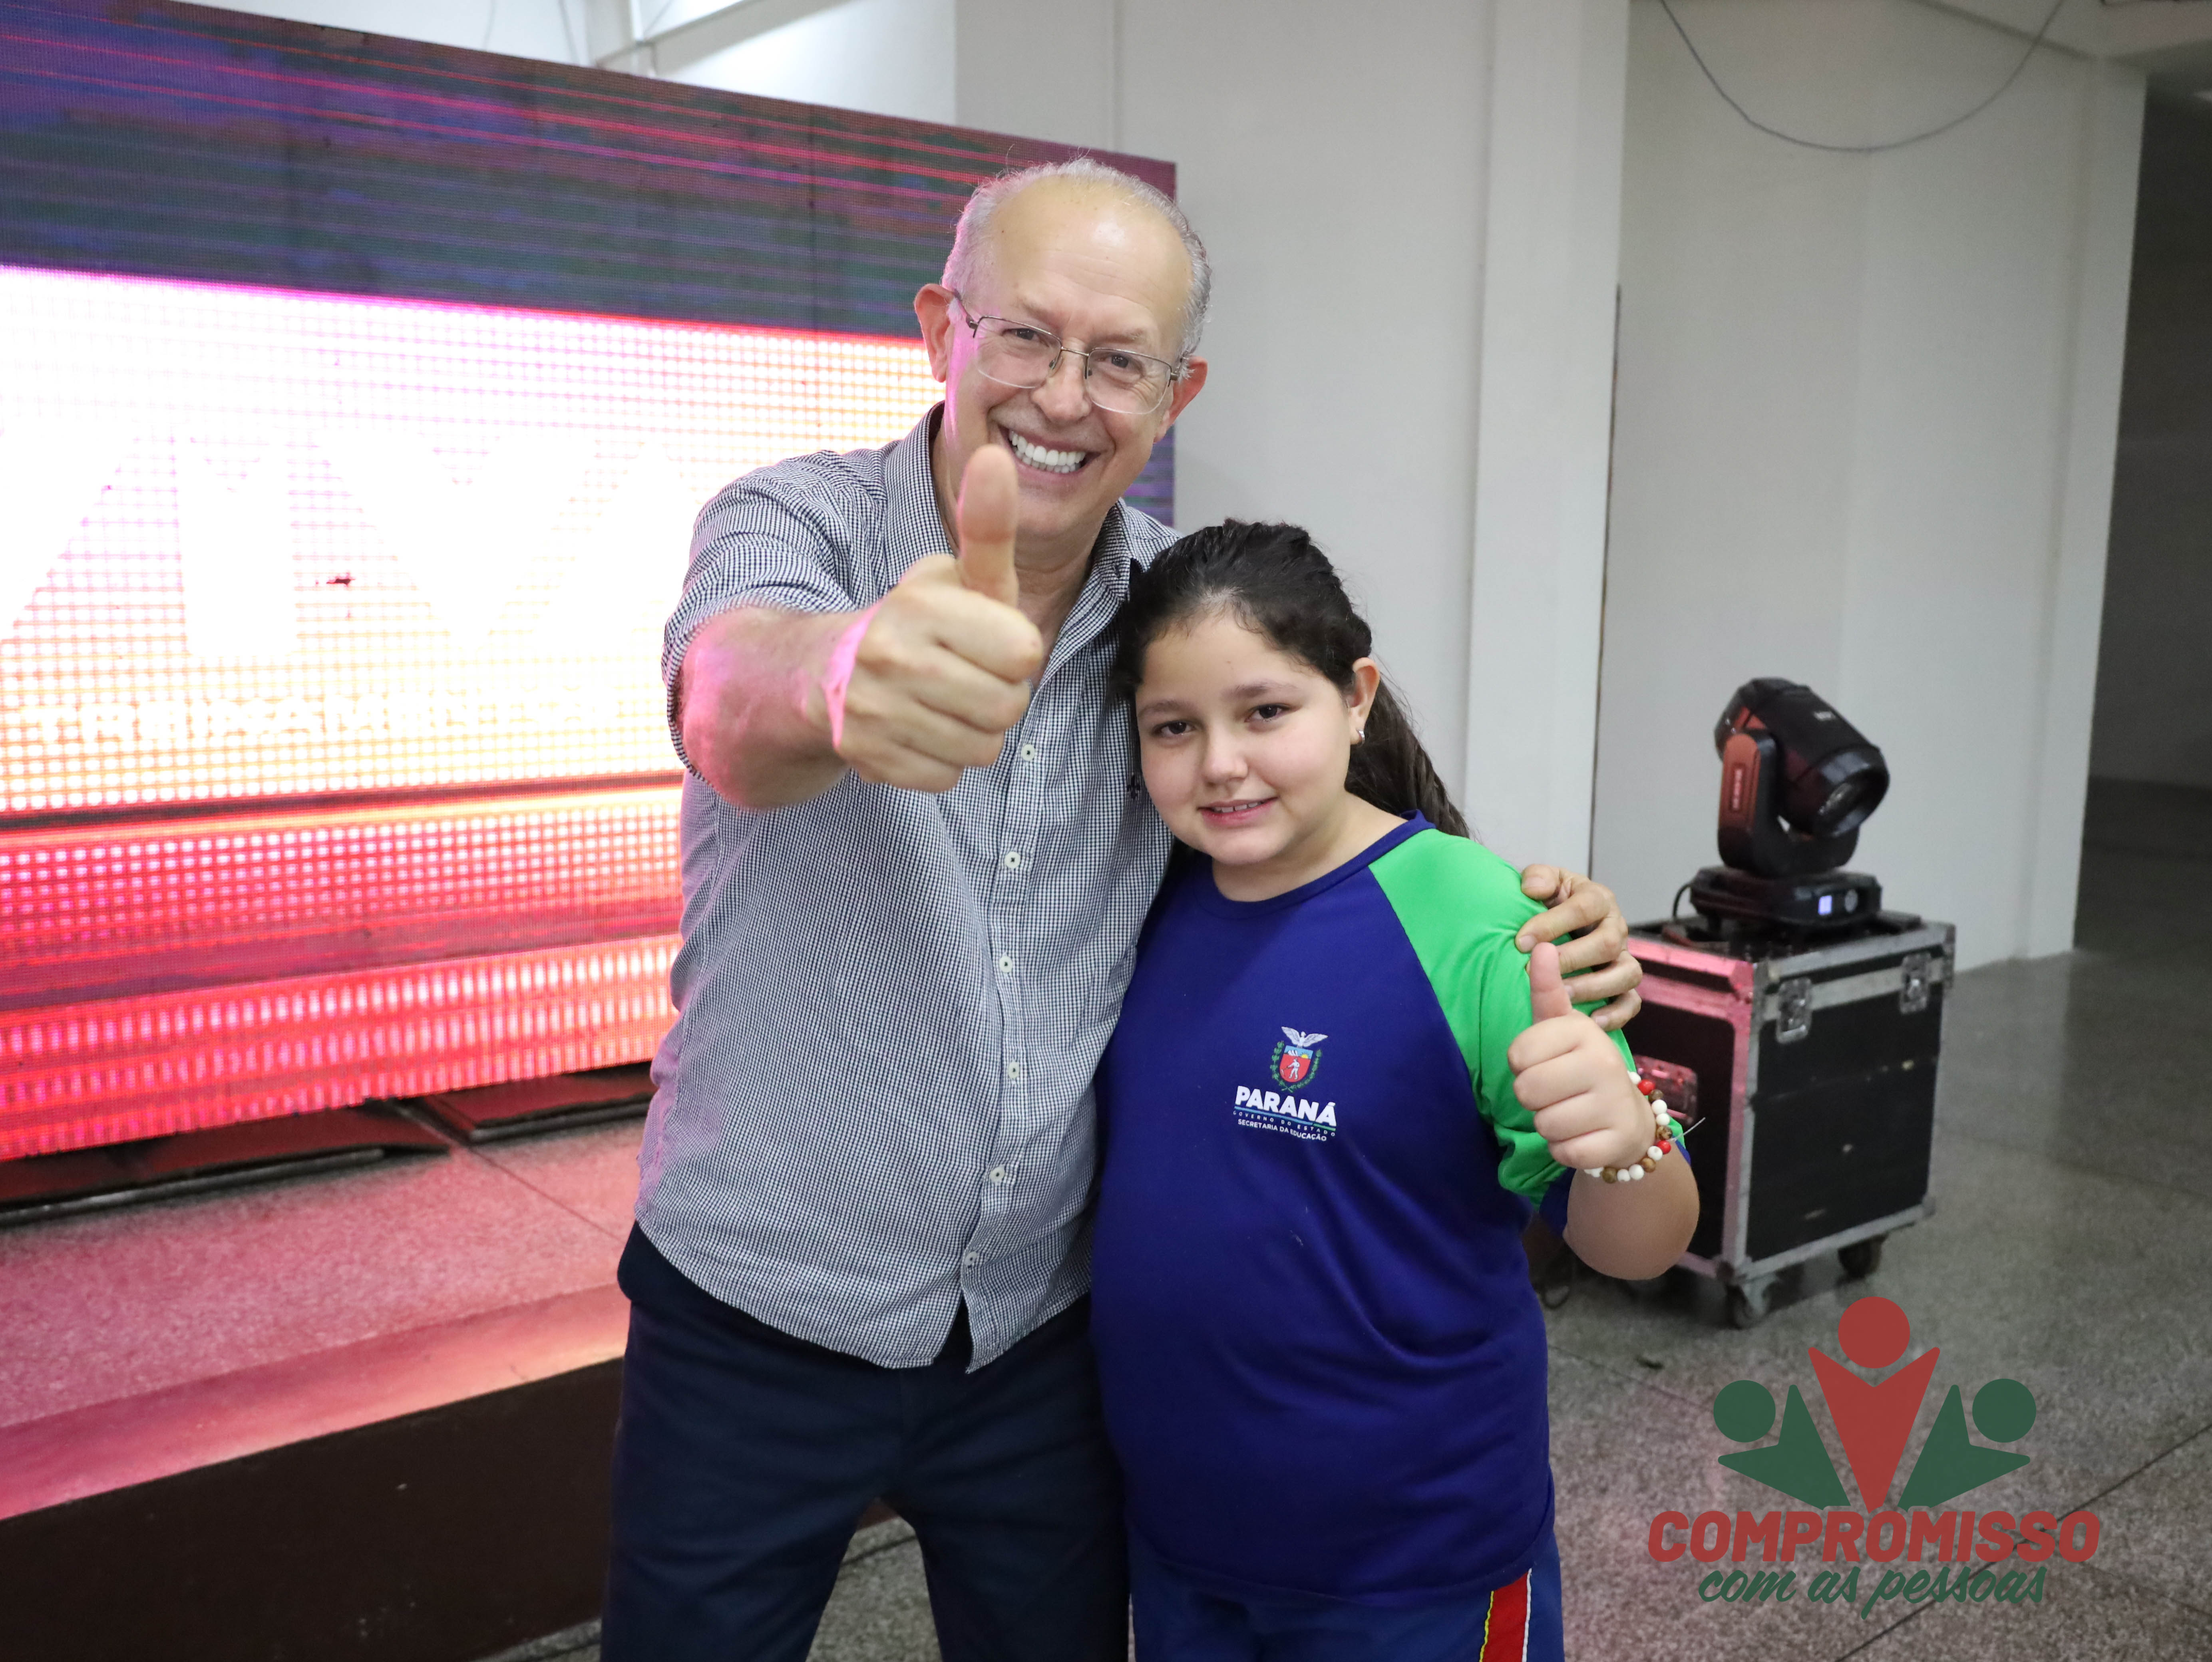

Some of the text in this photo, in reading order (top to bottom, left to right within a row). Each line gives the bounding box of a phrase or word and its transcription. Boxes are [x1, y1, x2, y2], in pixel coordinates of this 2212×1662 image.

[1235, 1085, 1337, 1127] PARANÁ
[1233, 1111, 1274, 1122] GOVERNO
[1297, 1125, 1335, 1136] ESTADO
[1238, 1119, 1278, 1131] SECRETARIA
[1290, 1129, 1327, 1141] EDUCAÇÃO
